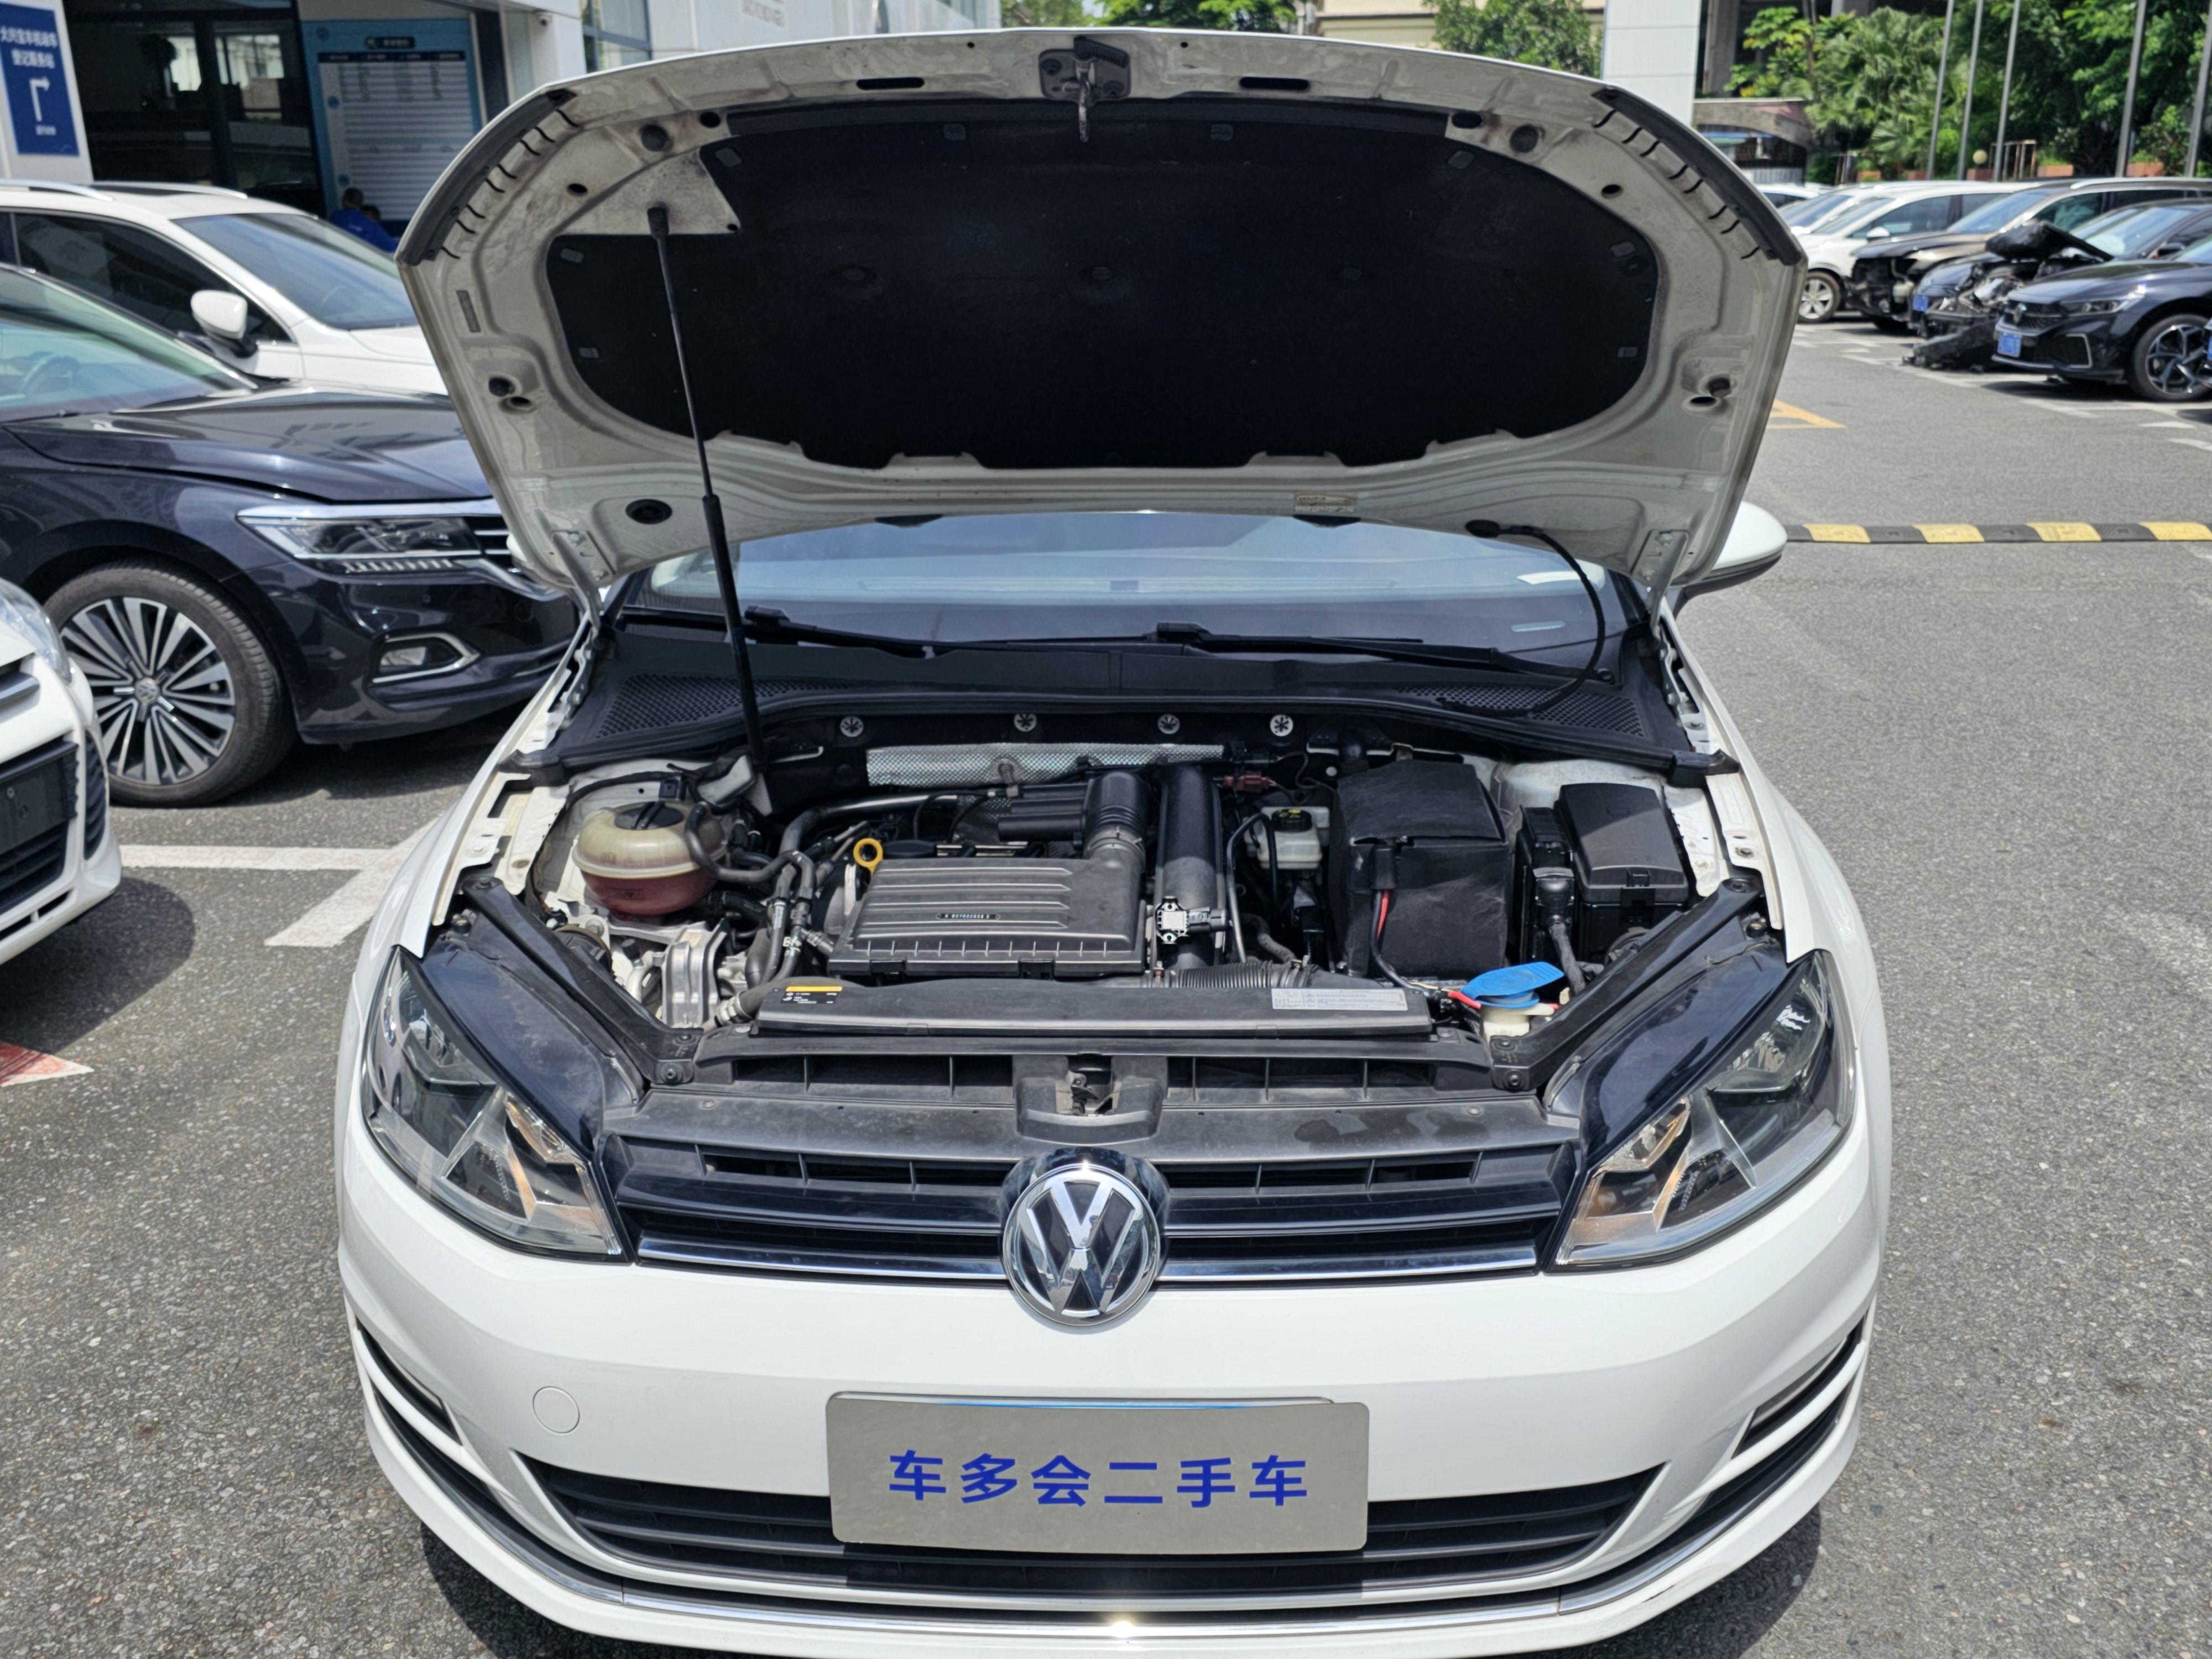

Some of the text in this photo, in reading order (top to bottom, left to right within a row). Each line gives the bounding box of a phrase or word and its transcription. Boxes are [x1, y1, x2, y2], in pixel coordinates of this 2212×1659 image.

[889, 1449, 1308, 1509] 车多会二手车
